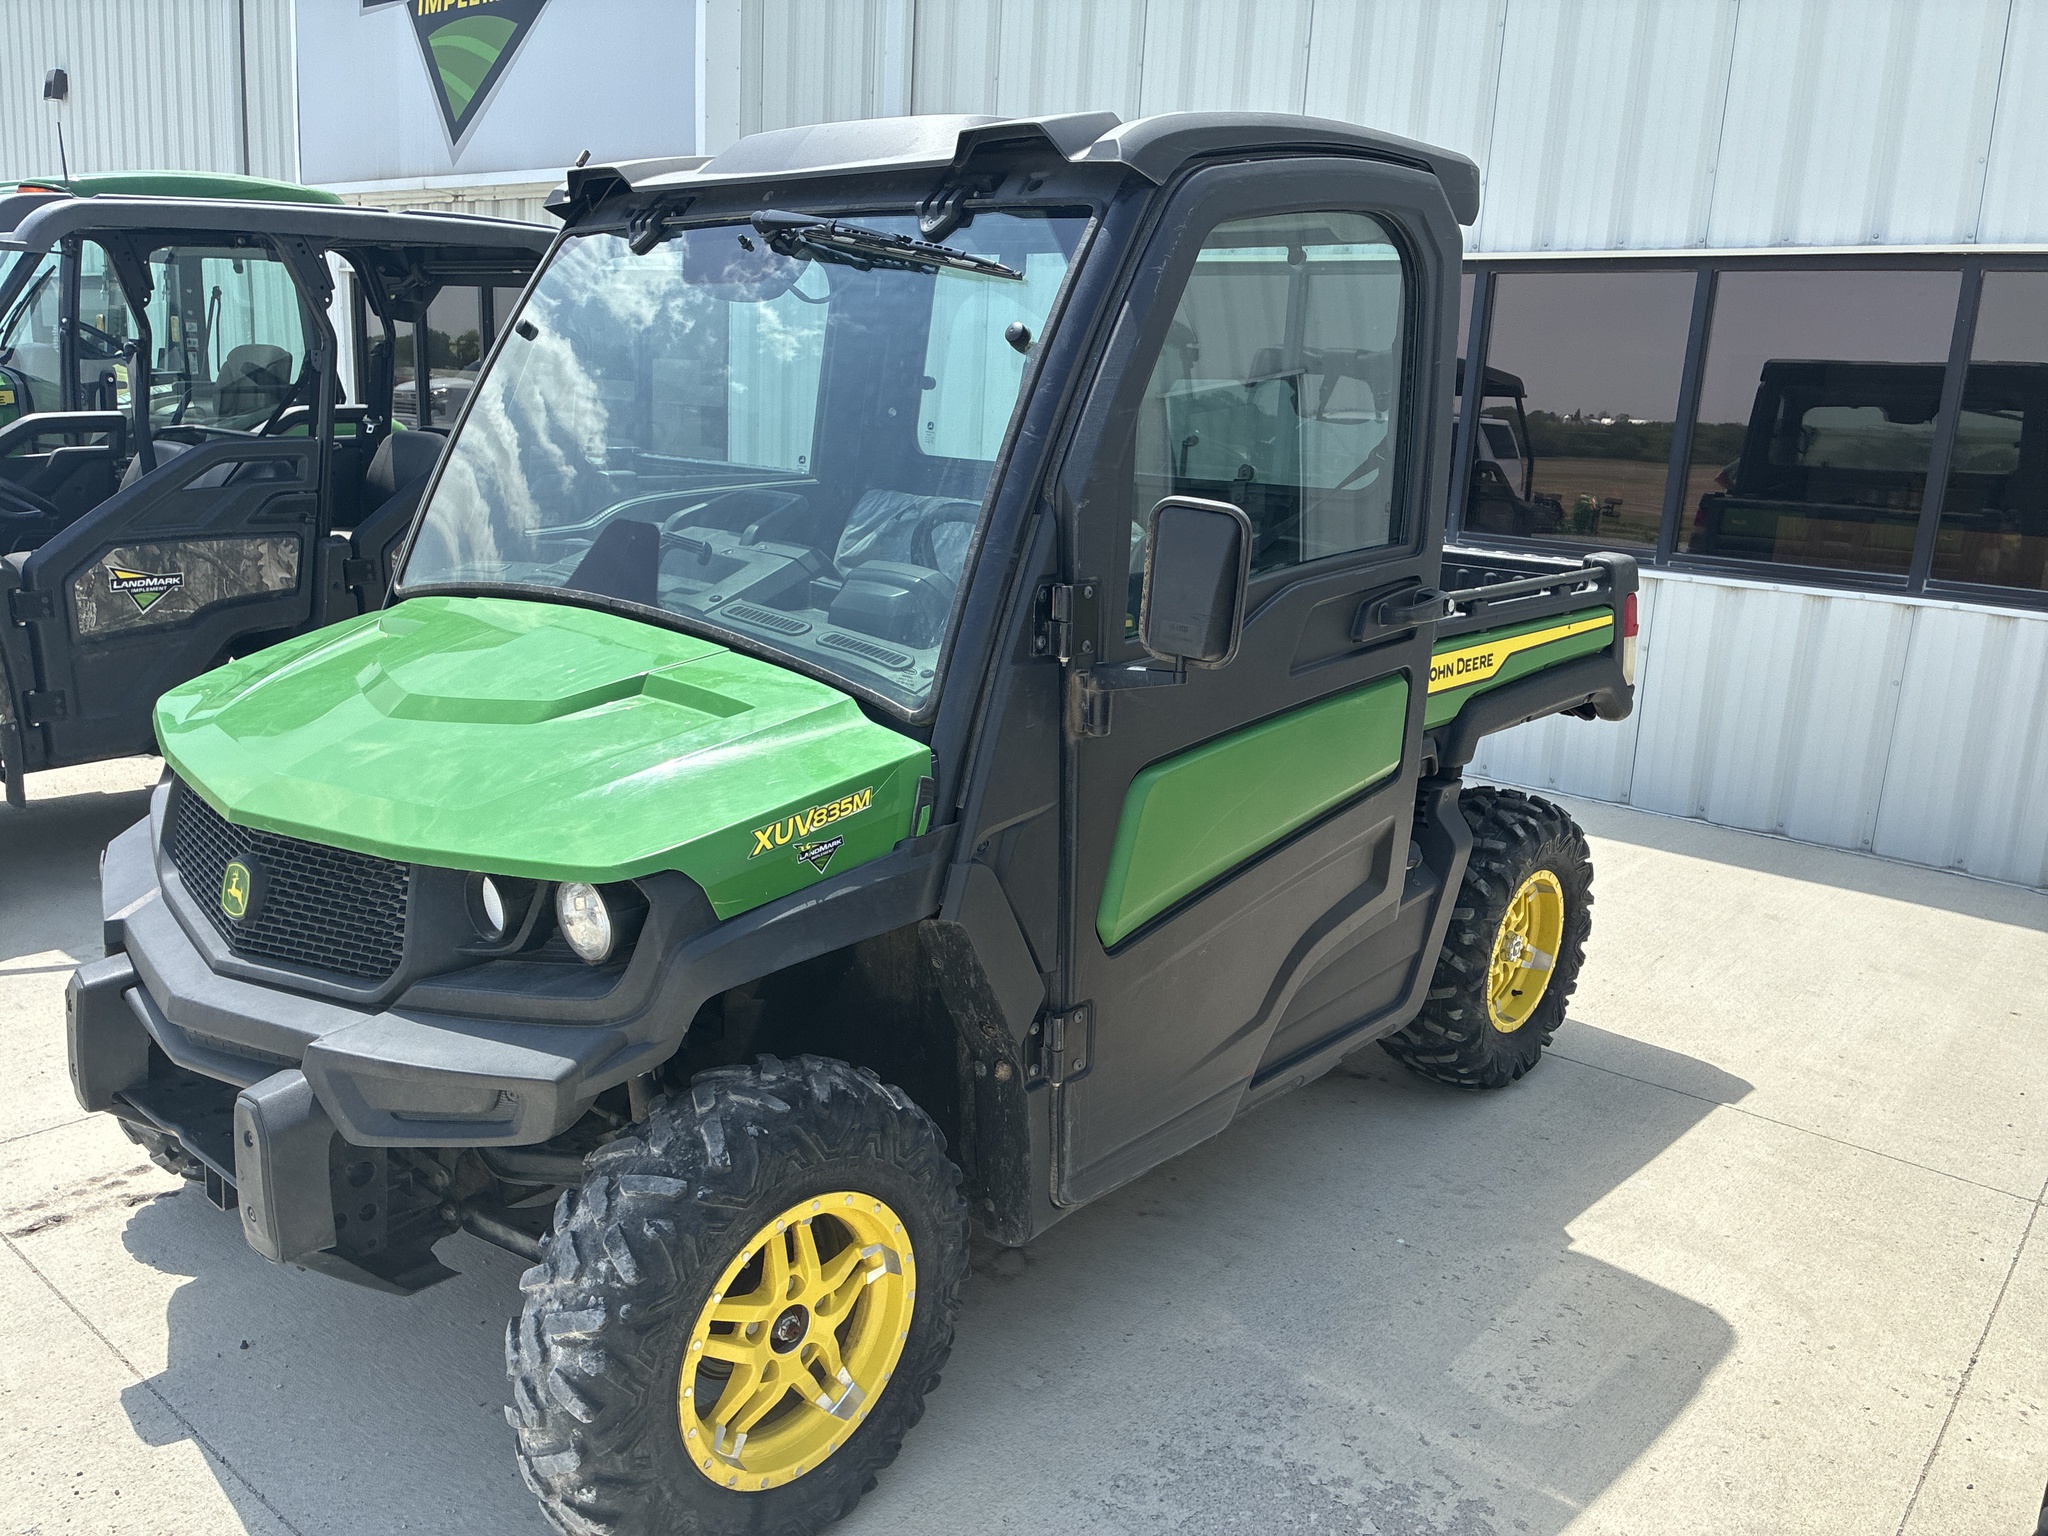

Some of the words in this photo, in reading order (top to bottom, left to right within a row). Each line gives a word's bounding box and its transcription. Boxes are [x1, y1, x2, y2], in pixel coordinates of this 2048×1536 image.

[417, 0, 499, 16] IMPL
[113, 576, 181, 589] LANDMARK
[1429, 662, 1454, 682] OHN
[1456, 652, 1494, 675] DEERE
